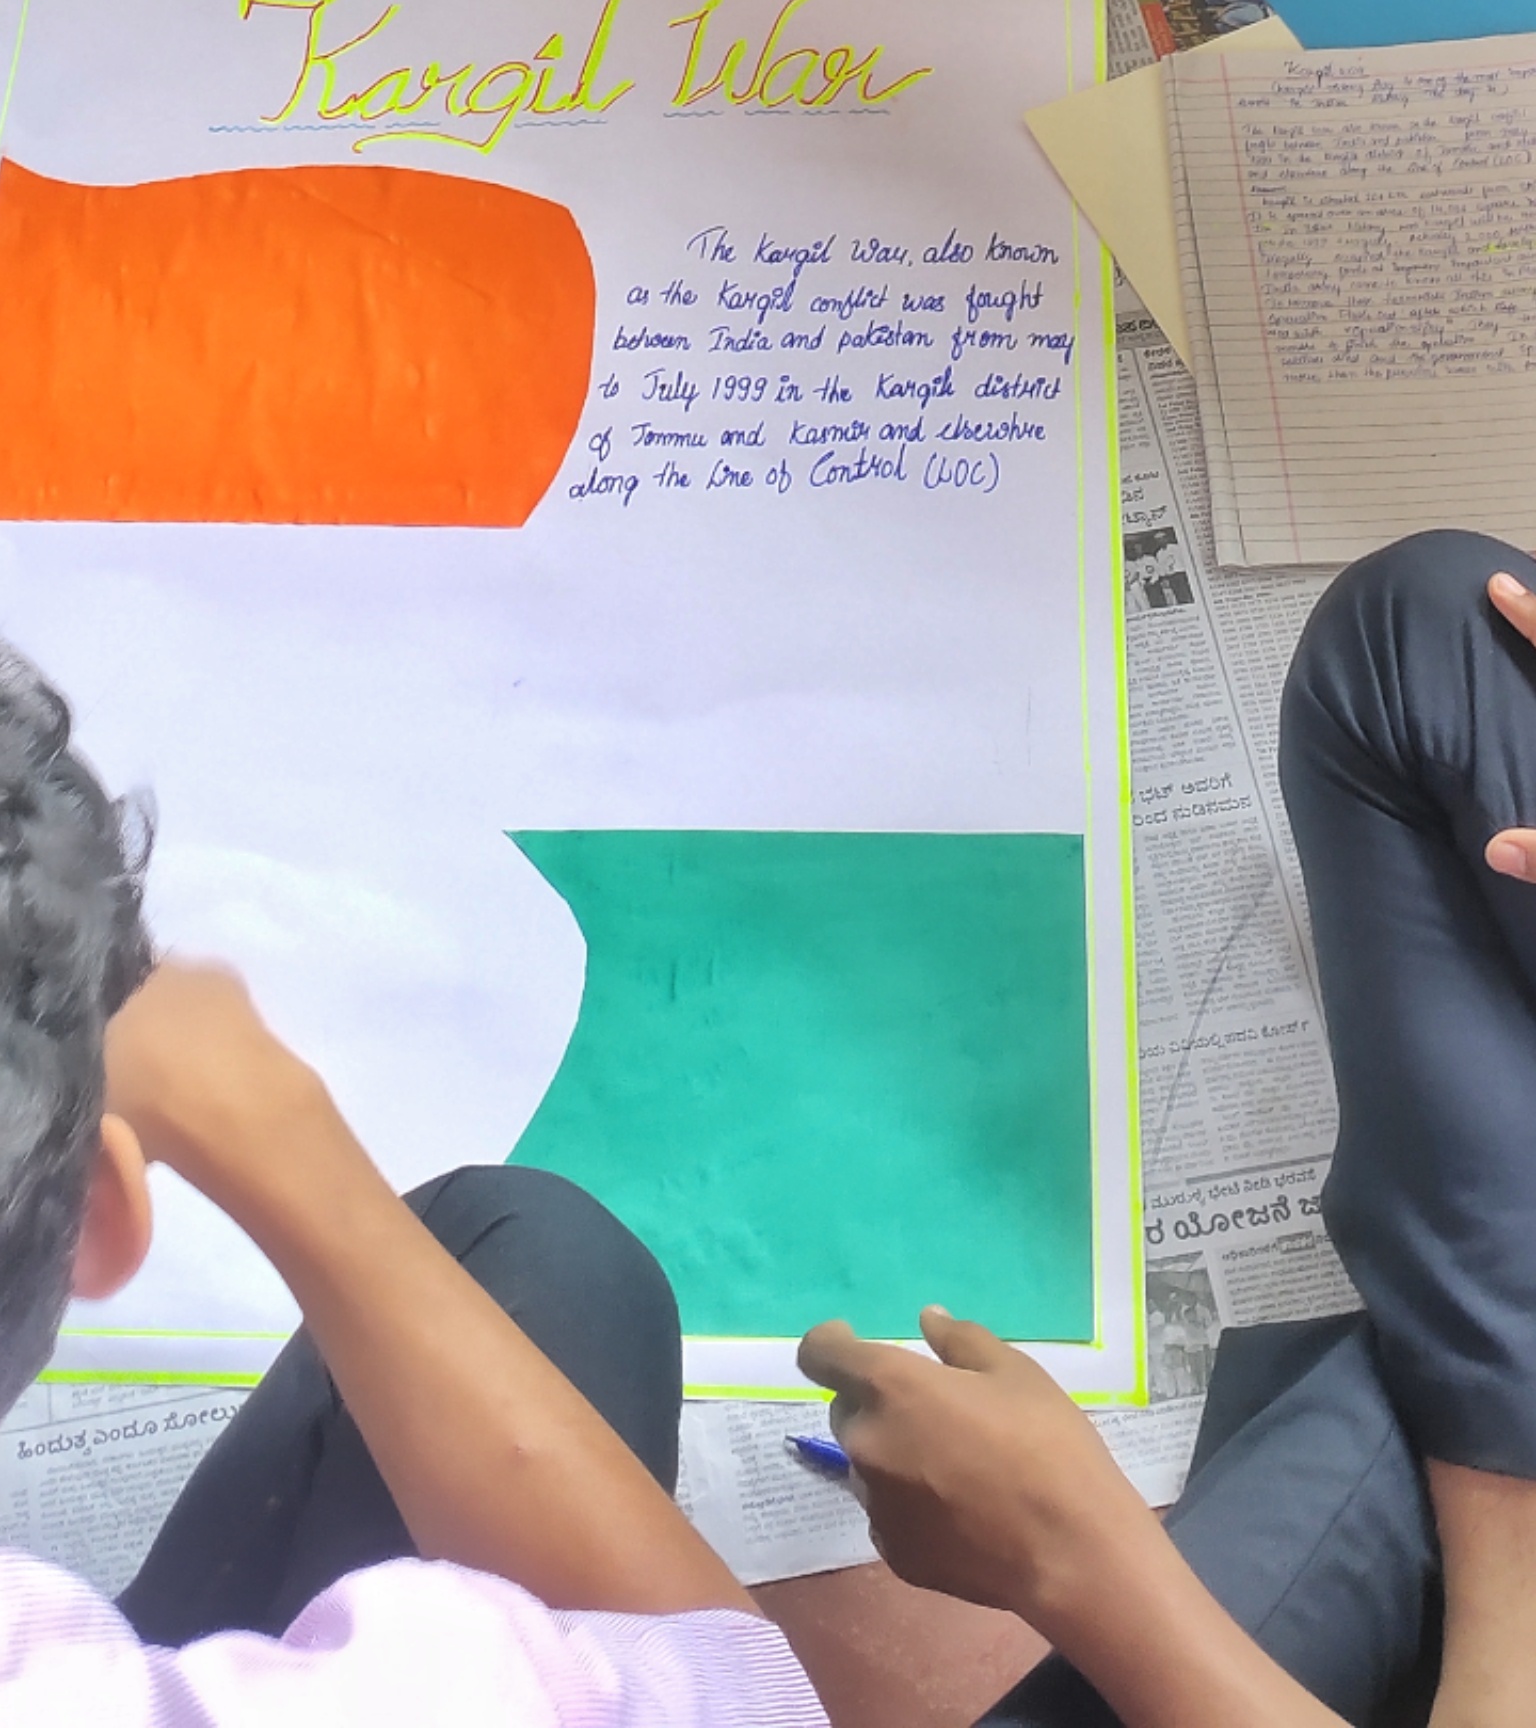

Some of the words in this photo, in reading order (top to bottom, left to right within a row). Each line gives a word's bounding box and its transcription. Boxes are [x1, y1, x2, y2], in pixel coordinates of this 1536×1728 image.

[687, 226, 737, 263] The
[923, 227, 974, 264] also
[626, 285, 650, 306] as
[659, 279, 699, 306] the
[717, 278, 797, 325] Kargil
[809, 284, 890, 321] conflict
[901, 292, 946, 313] was
[965, 279, 1044, 324] fought
[708, 325, 773, 353] India
[780, 324, 826, 351] and
[951, 325, 1018, 362] from
[1026, 332, 1076, 366] may
[597, 373, 620, 399] to
[641, 368, 701, 413] July
[712, 374, 769, 402] 1999
[774, 374, 804, 403] in
[813, 374, 854, 404] the
[973, 372, 1062, 400] district
[588, 425, 614, 463] of
[720, 420, 766, 447] and
[878, 415, 926, 443] and
[569, 466, 641, 508] along
[652, 460, 693, 488] the
[764, 458, 792, 494] of
[809, 442, 909, 488] Control
[1172, 1193, 1292, 1240] ಯೋಜನೆ
[16, 1428, 92, 1461] ಹಿಂದುತ್ವ
[92, 1419, 159, 1447] ಎಂದೂ
